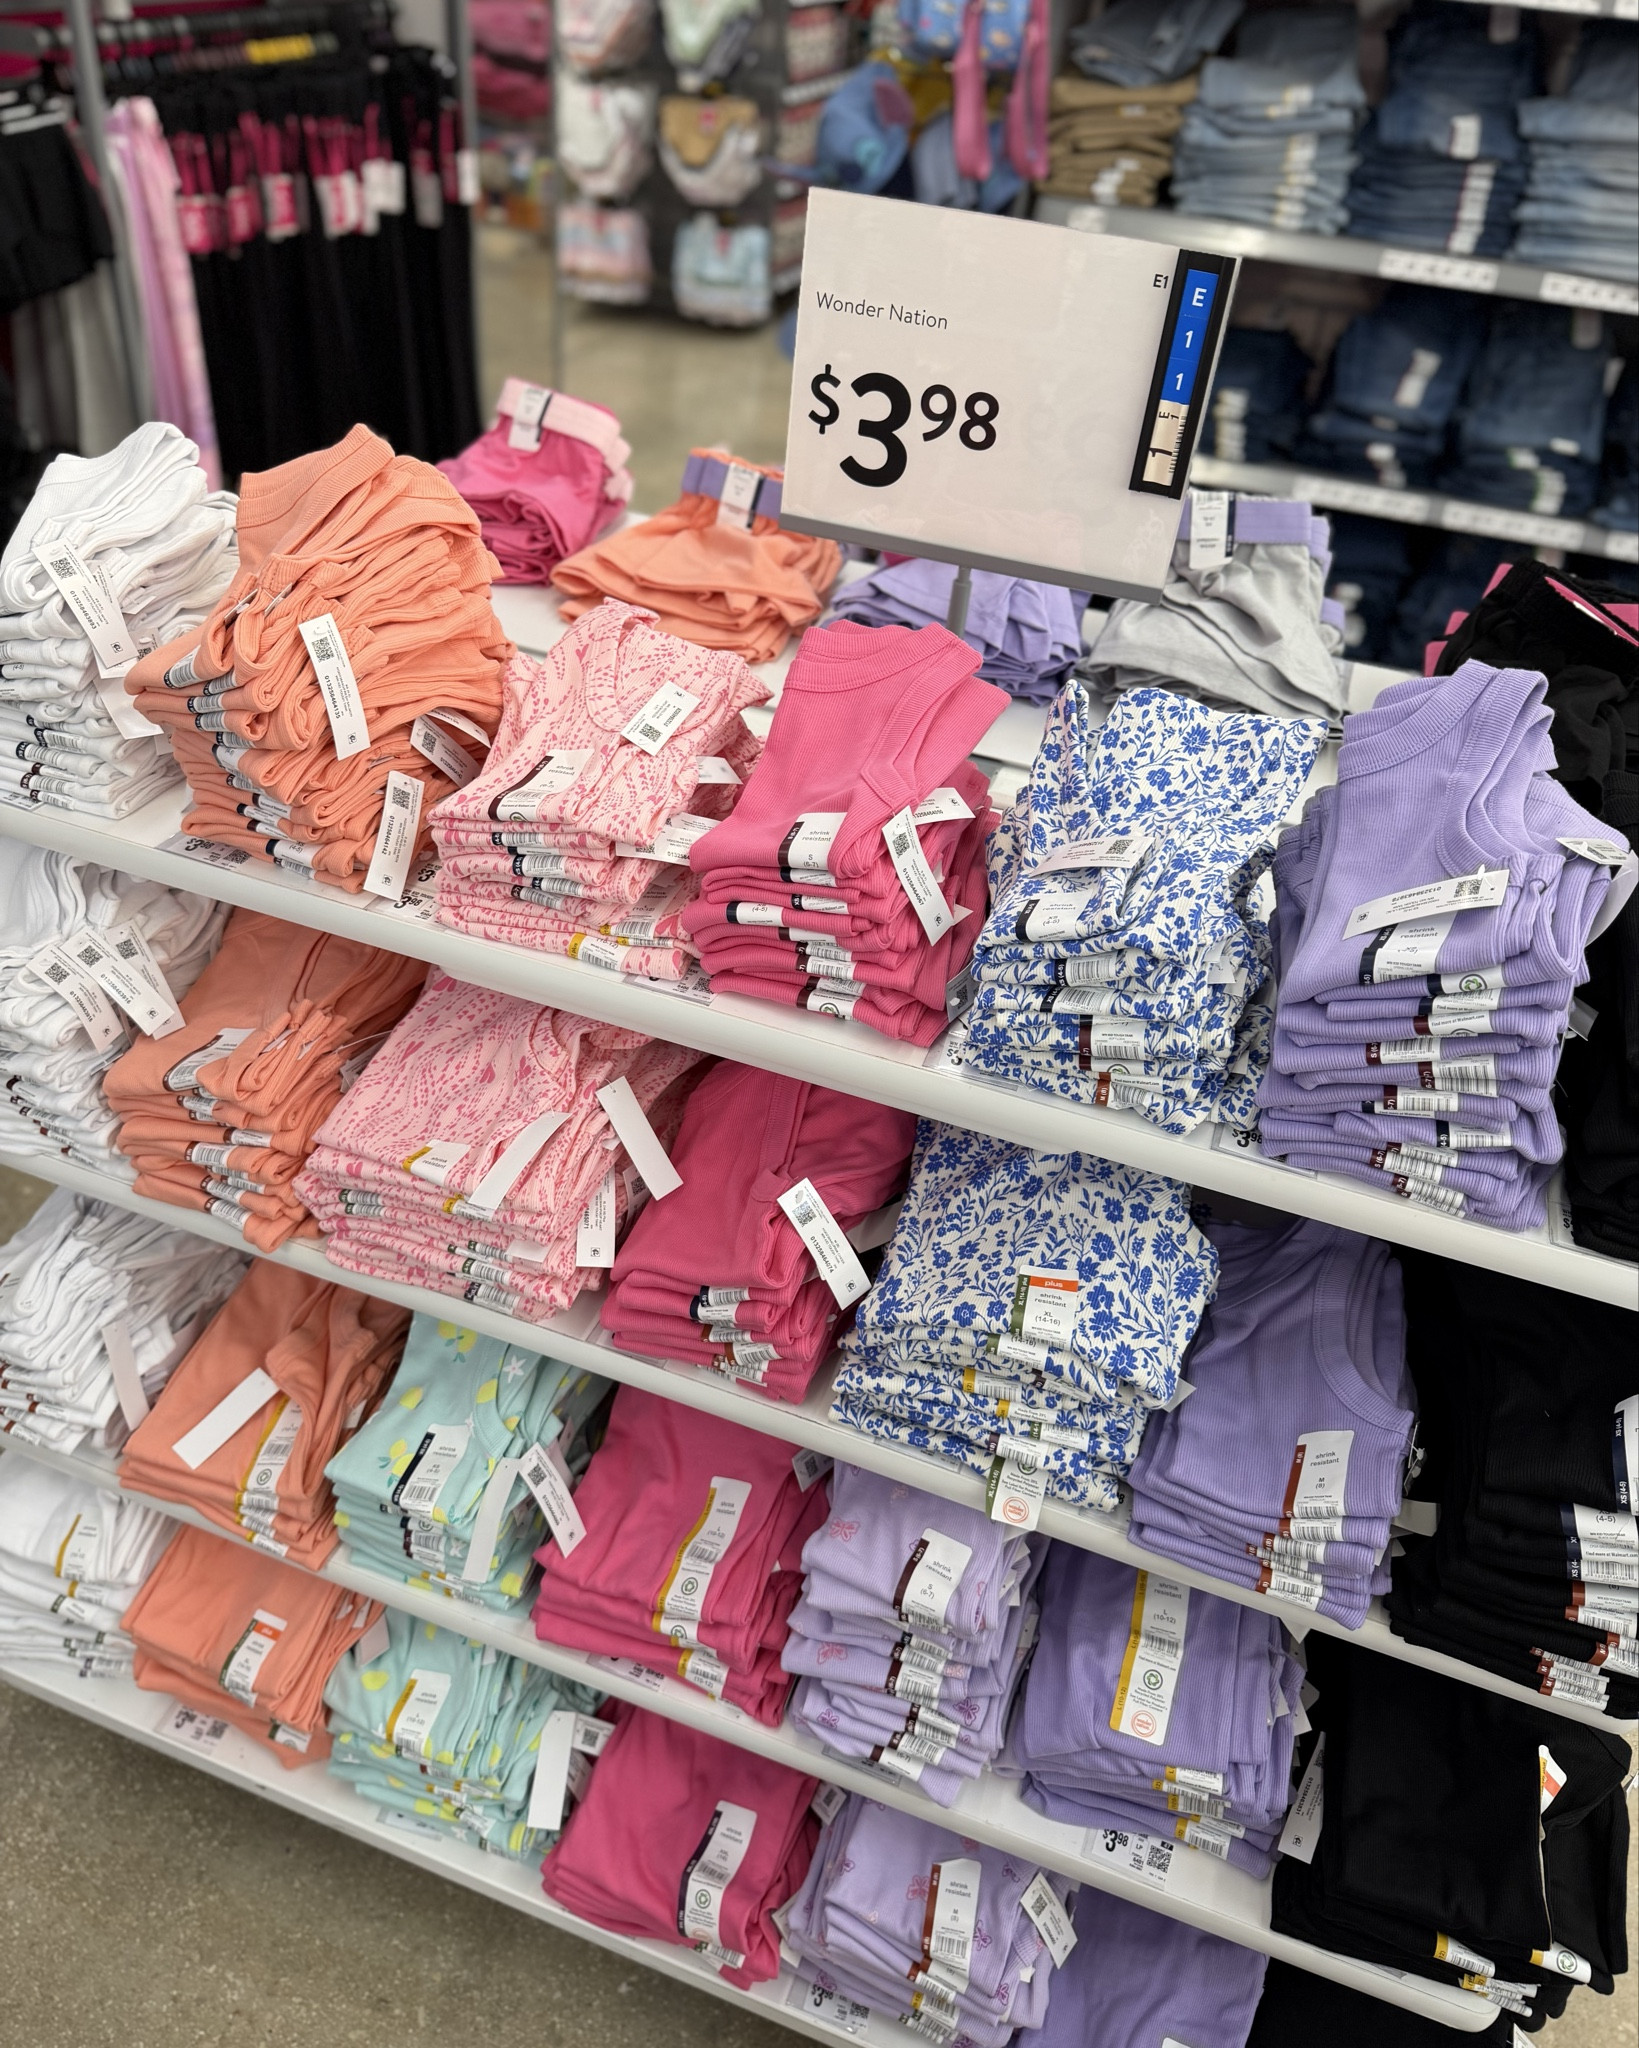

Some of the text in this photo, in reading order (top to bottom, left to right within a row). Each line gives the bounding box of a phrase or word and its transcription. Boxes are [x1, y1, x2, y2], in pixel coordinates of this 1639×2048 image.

[1152, 274, 1169, 289] E1
[1192, 287, 1207, 307] E
[816, 291, 949, 329] Wonder Nation
[1184, 330, 1194, 349] 1
[1175, 373, 1184, 391] 1
[1044, 1280, 1063, 1288] plus
[1040, 1292, 1062, 1300] shrink
[1034, 1297, 1066, 1308] resistant
[1035, 1315, 1061, 1326] (14-16)
[1315, 1451, 1336, 1459] shrink
[1310, 1457, 1339, 1467] resistant
[1621, 1495, 1628, 1504] XS
[1595, 1515, 1616, 1523] (4-5)
[933, 1561, 952, 1573] shrink
[926, 1564, 952, 1582] resistant
[1159, 1583, 1178, 1591] shrink
[920, 1588, 935, 1600] (6-7)
[1154, 1589, 1182, 1599] resistant
[1153, 1613, 1176, 1624] (10-12)
[1102, 1828, 1129, 1852] $398
